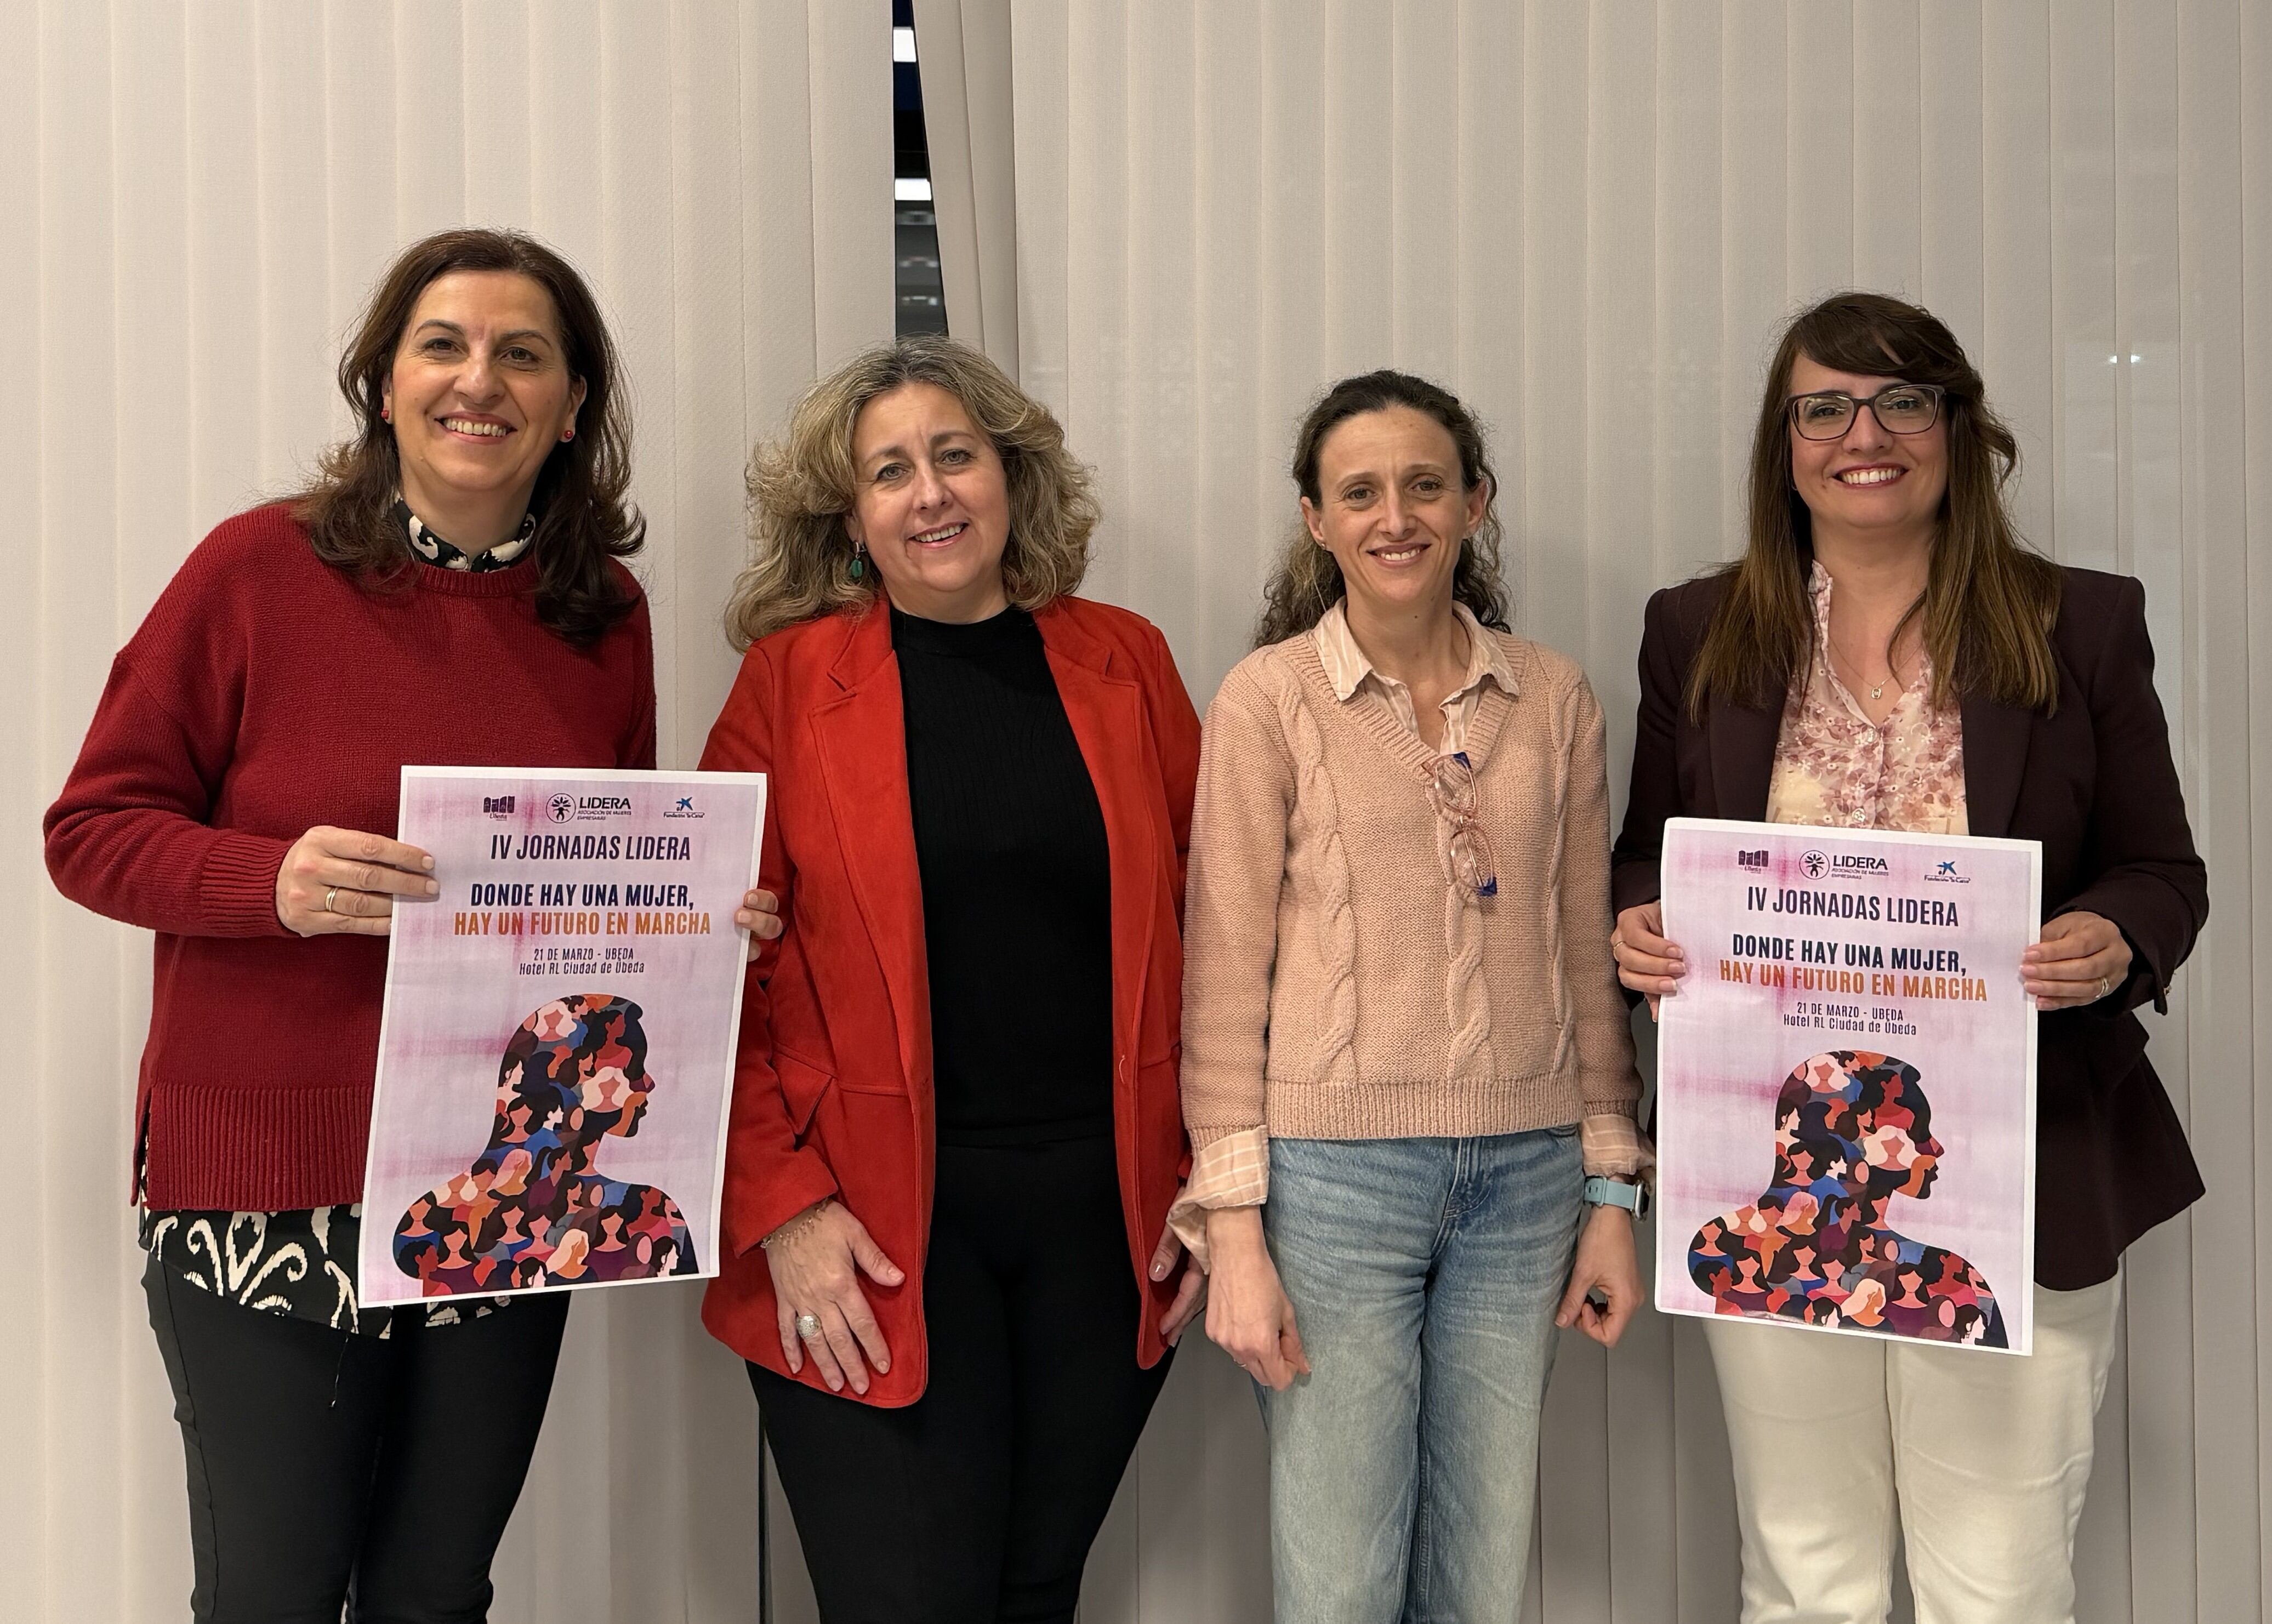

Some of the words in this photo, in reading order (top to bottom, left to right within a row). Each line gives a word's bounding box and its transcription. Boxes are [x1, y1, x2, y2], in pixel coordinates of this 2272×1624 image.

[579, 797, 631, 810] LIDERA
[491, 835, 512, 859] IV
[516, 835, 620, 860] JORNADAS
[625, 836, 691, 861] LIDERA
[1833, 855, 1888, 870] LIDERA
[471, 884, 534, 907] DONDE
[540, 884, 577, 907] HAY
[582, 884, 618, 907] UNA
[625, 885, 694, 910] MUJER,
[1747, 886, 1766, 911] IV
[1772, 889, 1880, 921] JORNADAS
[1887, 898, 1958, 926] LIDERA
[454, 912, 492, 935] HAY
[498, 912, 523, 934] UN
[531, 912, 600, 934] FUTURO
[607, 912, 629, 934] EN
[635, 912, 710, 934] MARCHA
[534, 948, 543, 961] 21
[548, 948, 559, 960] DE
[562, 948, 593, 961] MARZO
[1733, 933, 1794, 960] DONDE
[1802, 940, 1838, 964] HAY
[1845, 944, 1883, 968] UNA
[1892, 948, 1967, 976] MUJER,
[519, 962, 545, 975] Hotel
[549, 962, 560, 975] RL
[563, 962, 596, 975] Ciudad
[601, 962, 612, 973] de
[1719, 960, 1753, 984] HAY
[1759, 964, 1784, 987] UN
[1793, 968, 1864, 994] FUTURO
[1872, 974, 1895, 996] EN
[1903, 976, 1988, 1001] MARCHA
[1797, 1002, 1807, 1014] 21
[1812, 1004, 1823, 1015] DE
[1827, 1005, 1859, 1018] MARZO
[1784, 1014, 1809, 1028] Hotel
[1814, 1016, 1825, 1029] RL
[1829, 1018, 1864, 1032] Ciudad
[1868, 1020, 1881, 1033] de
